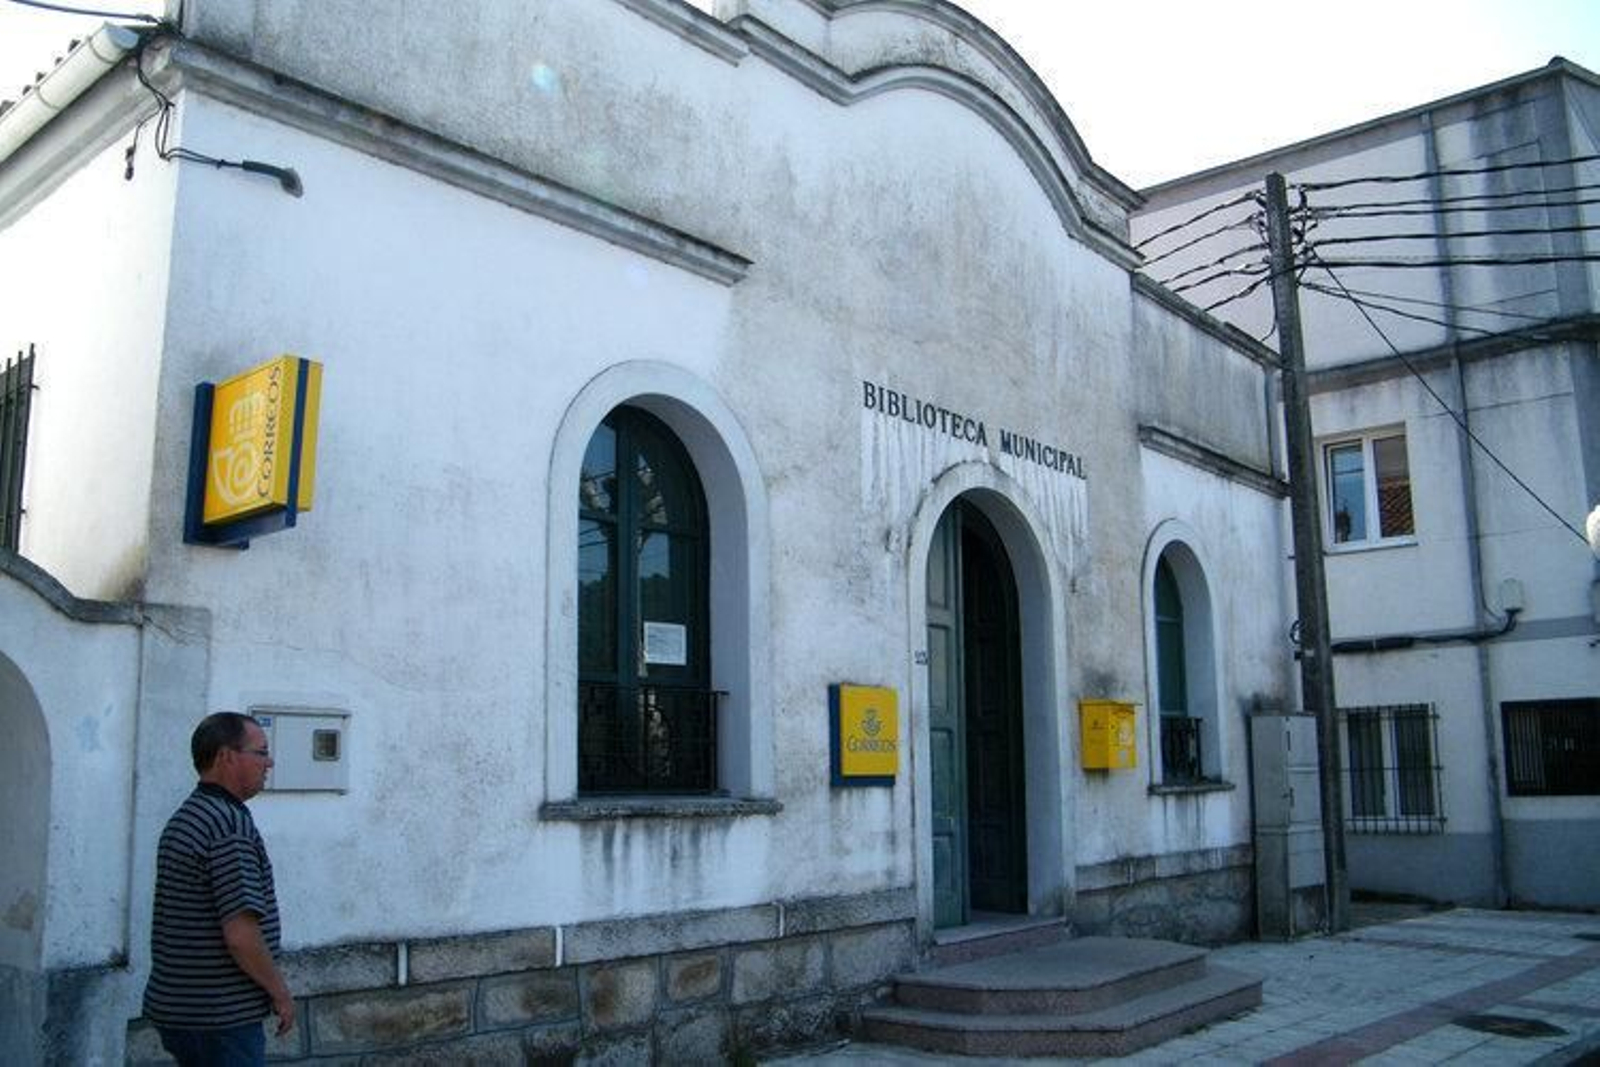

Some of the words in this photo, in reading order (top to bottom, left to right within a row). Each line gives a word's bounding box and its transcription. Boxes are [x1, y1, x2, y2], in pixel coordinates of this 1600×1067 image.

[258, 366, 281, 498] CORREOS
[863, 380, 988, 447] BIBLIOTECA
[1000, 428, 1087, 480] MUNICIPAL
